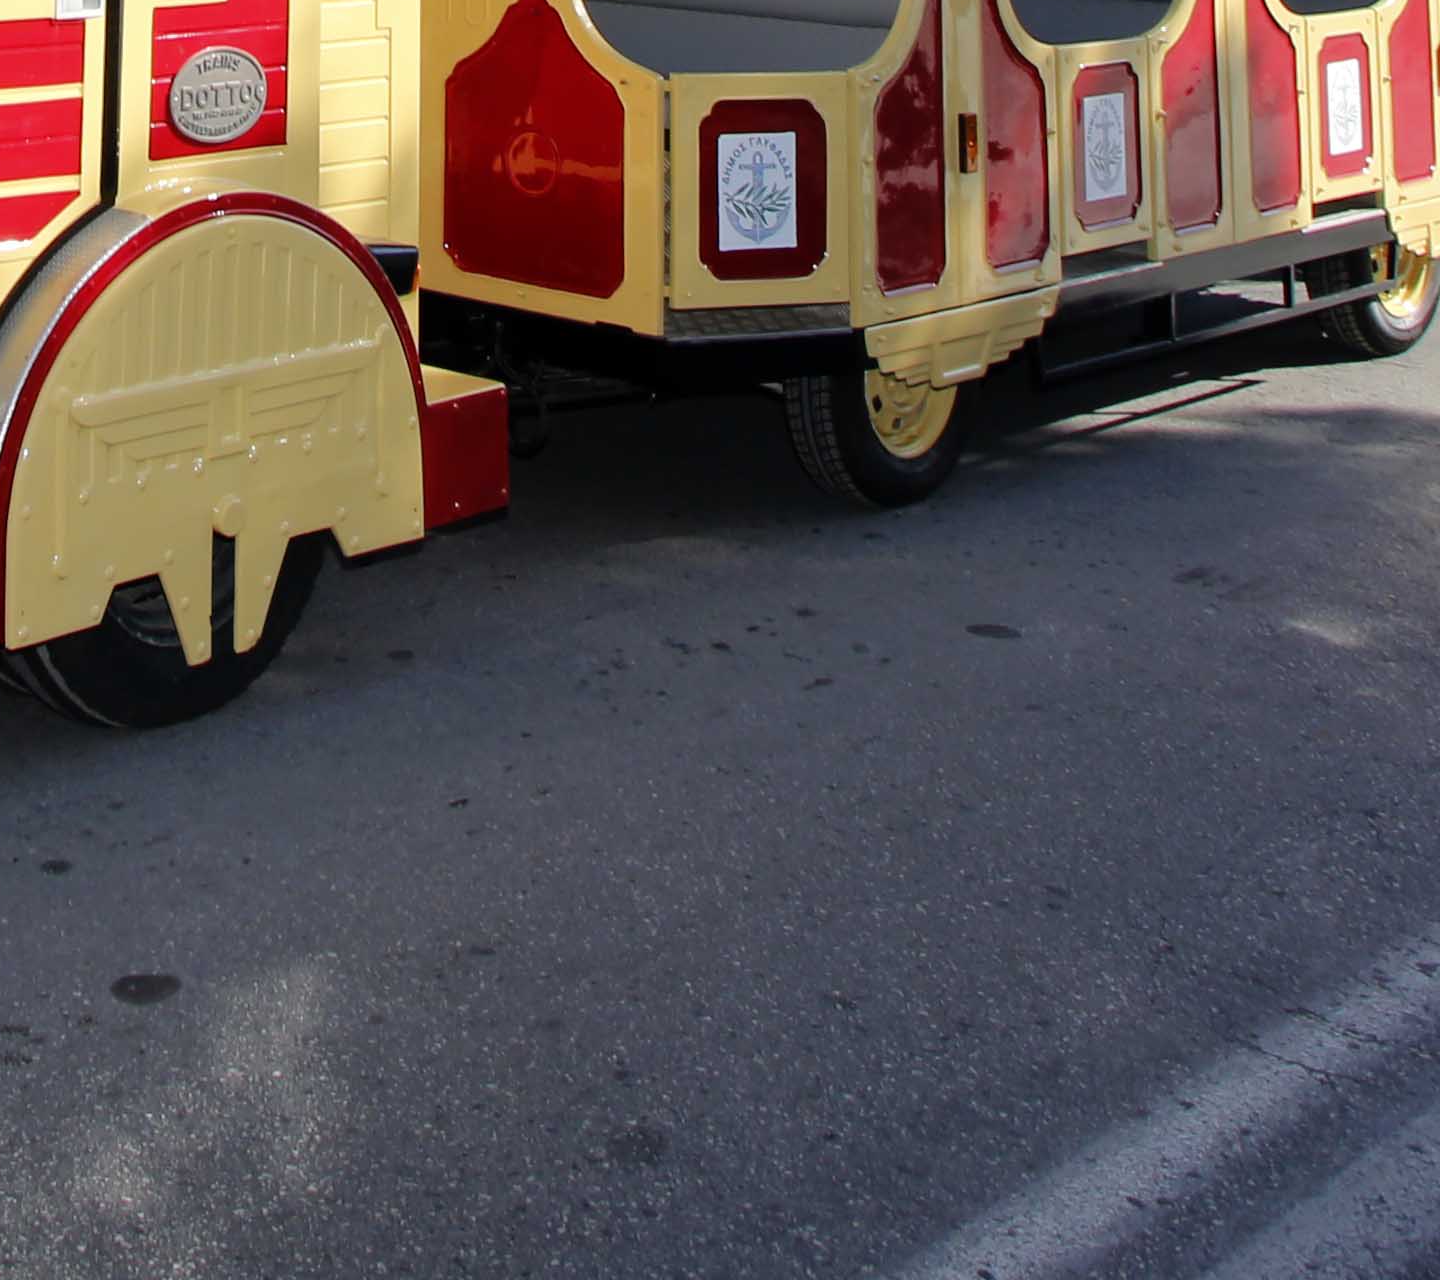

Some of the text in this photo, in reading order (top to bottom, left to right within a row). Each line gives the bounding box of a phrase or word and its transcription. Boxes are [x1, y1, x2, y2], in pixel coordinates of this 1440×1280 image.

[193, 54, 241, 75] TRAINS
[180, 80, 252, 112] DOTTO
[722, 144, 747, 184] ΔΗΜΟΣ
